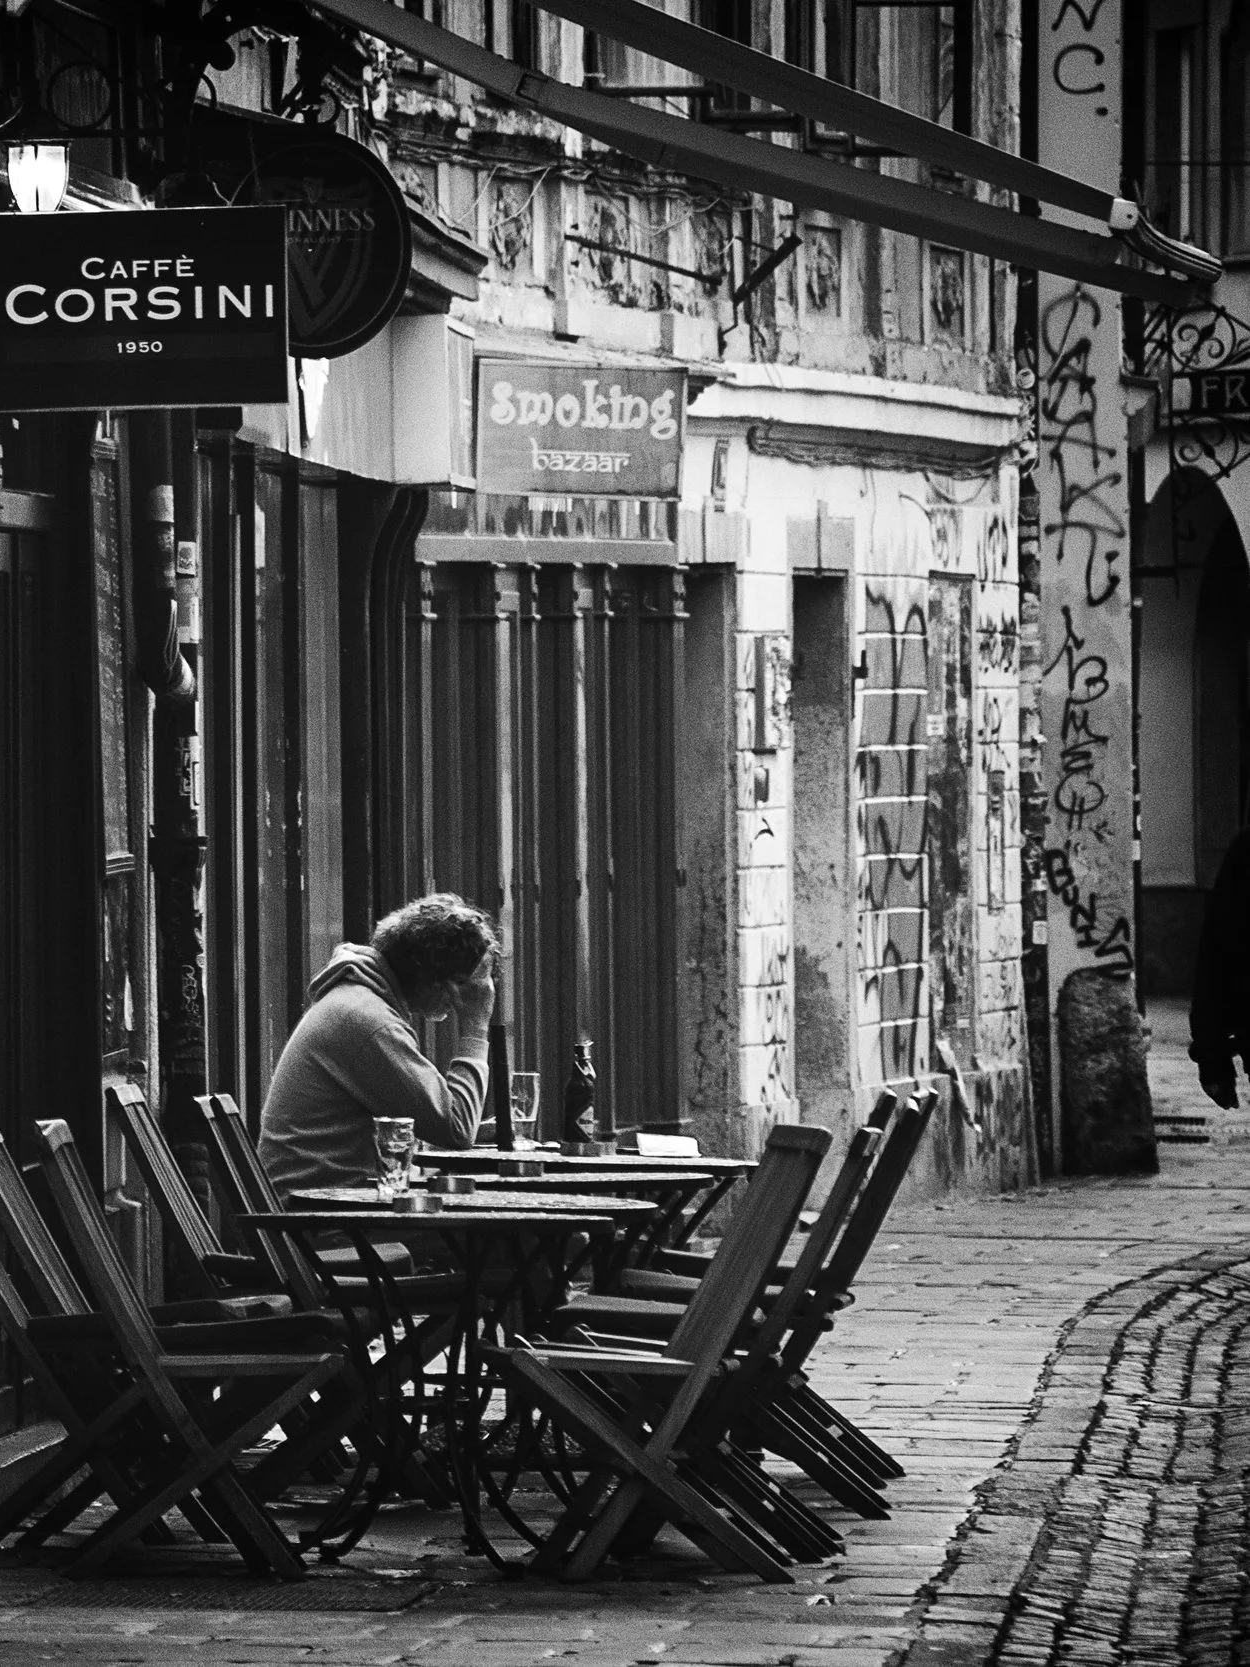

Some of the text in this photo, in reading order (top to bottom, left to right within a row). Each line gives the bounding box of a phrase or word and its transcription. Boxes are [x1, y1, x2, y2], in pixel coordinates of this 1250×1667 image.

[288, 208, 376, 233] INNESS
[81, 255, 195, 280] CAFFÈ
[5, 284, 274, 325] CORSINI
[117, 341, 163, 354] 1950
[490, 379, 678, 440] Smoking
[530, 437, 631, 473] bazaar
